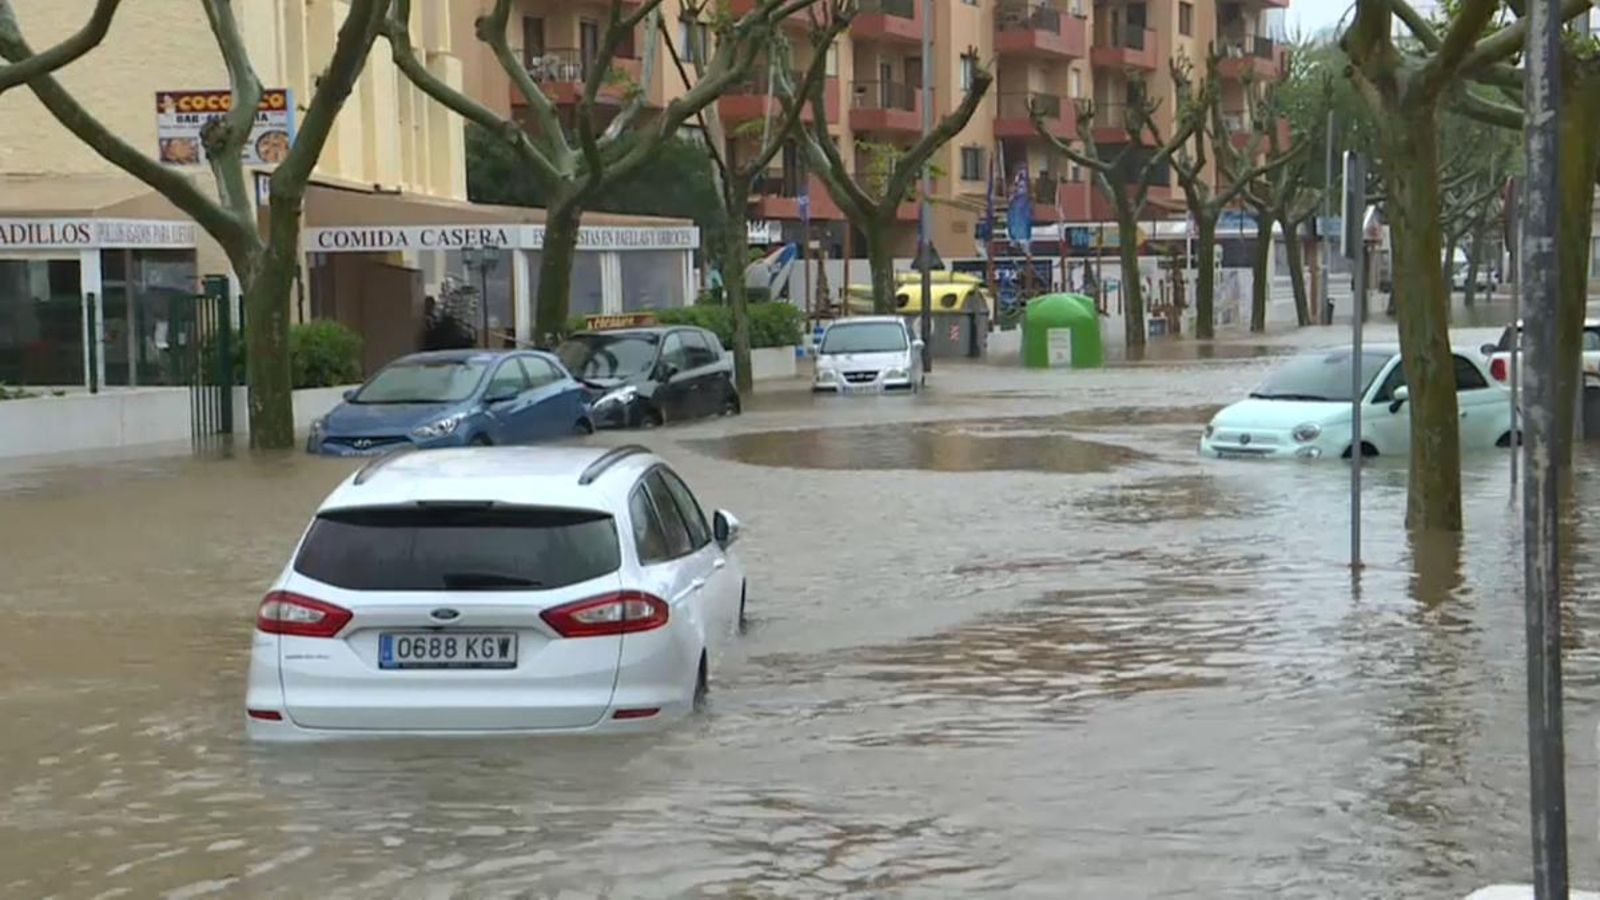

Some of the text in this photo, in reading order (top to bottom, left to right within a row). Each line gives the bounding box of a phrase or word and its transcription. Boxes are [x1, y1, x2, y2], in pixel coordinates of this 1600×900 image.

[318, 228, 509, 248] COMIDA CASERA
[398, 637, 511, 659] 0688 KGW
